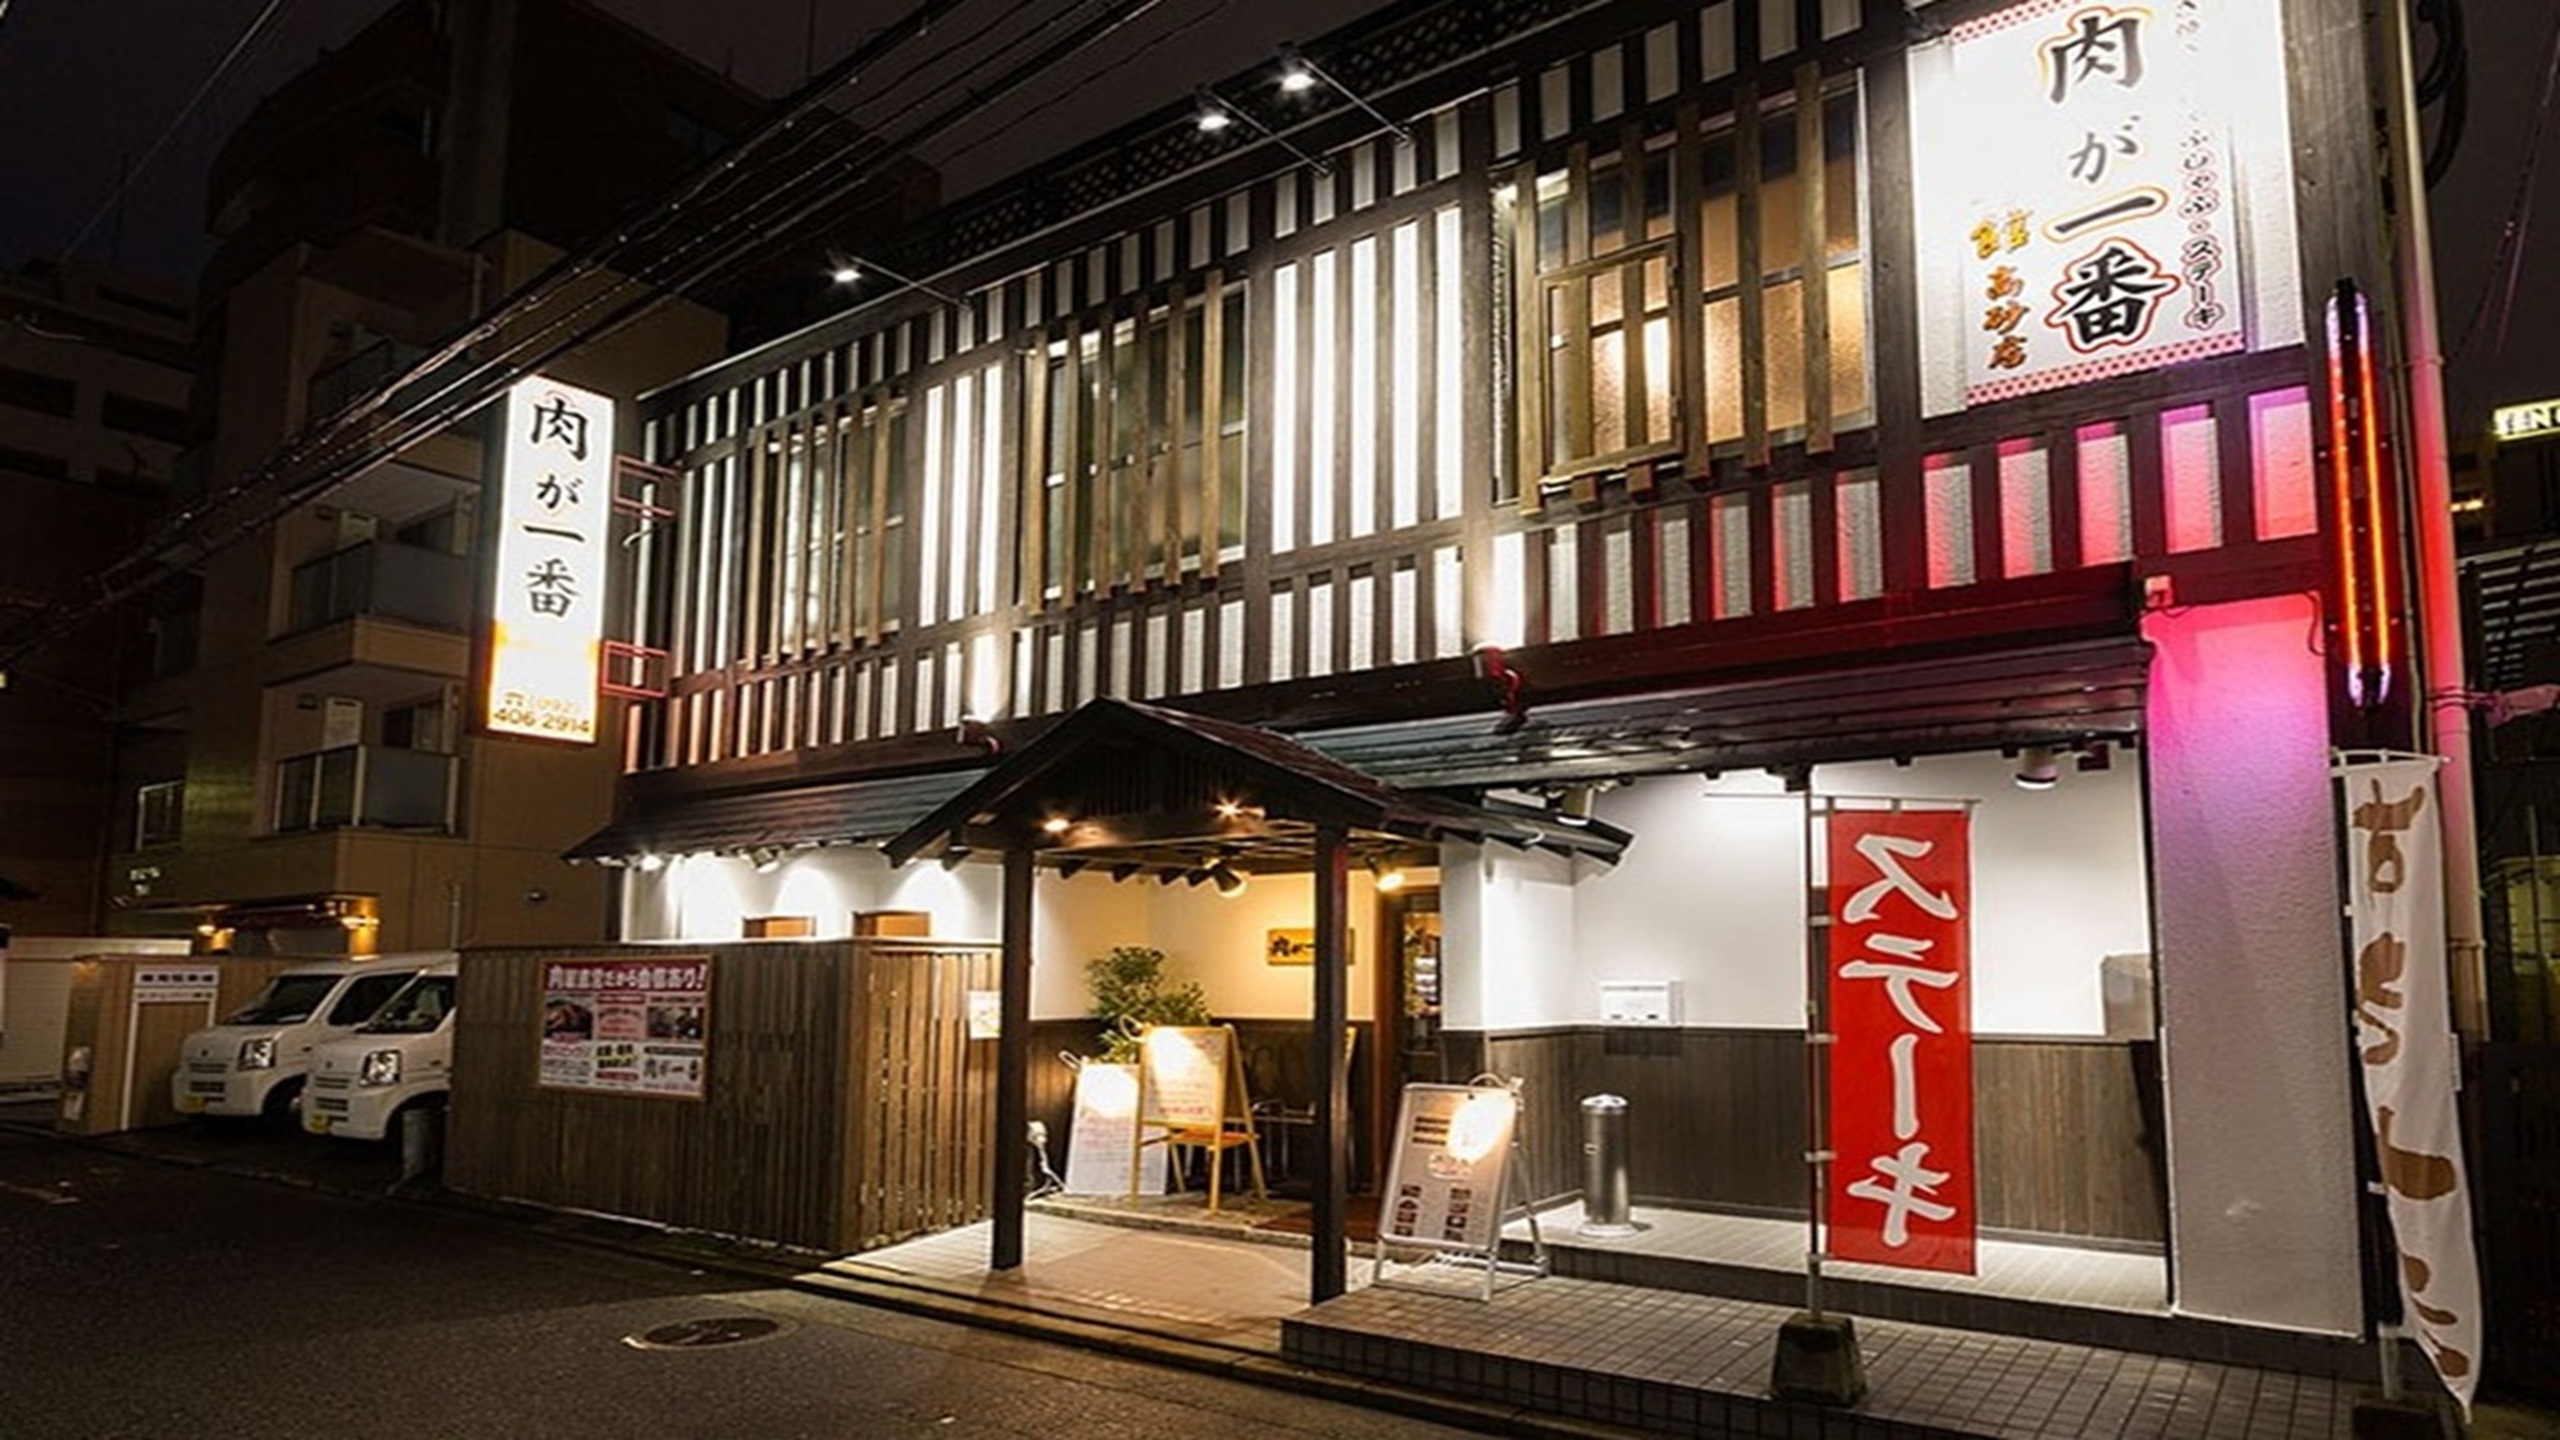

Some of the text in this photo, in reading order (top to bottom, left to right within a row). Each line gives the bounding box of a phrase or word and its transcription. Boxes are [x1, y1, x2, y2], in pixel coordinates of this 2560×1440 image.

[2050, 15, 2168, 345] 肉が一番
[2496, 403, 2560, 435] TEN
[522, 398, 588, 618] 肉が一番
[493, 708, 590, 733] 406 2914
